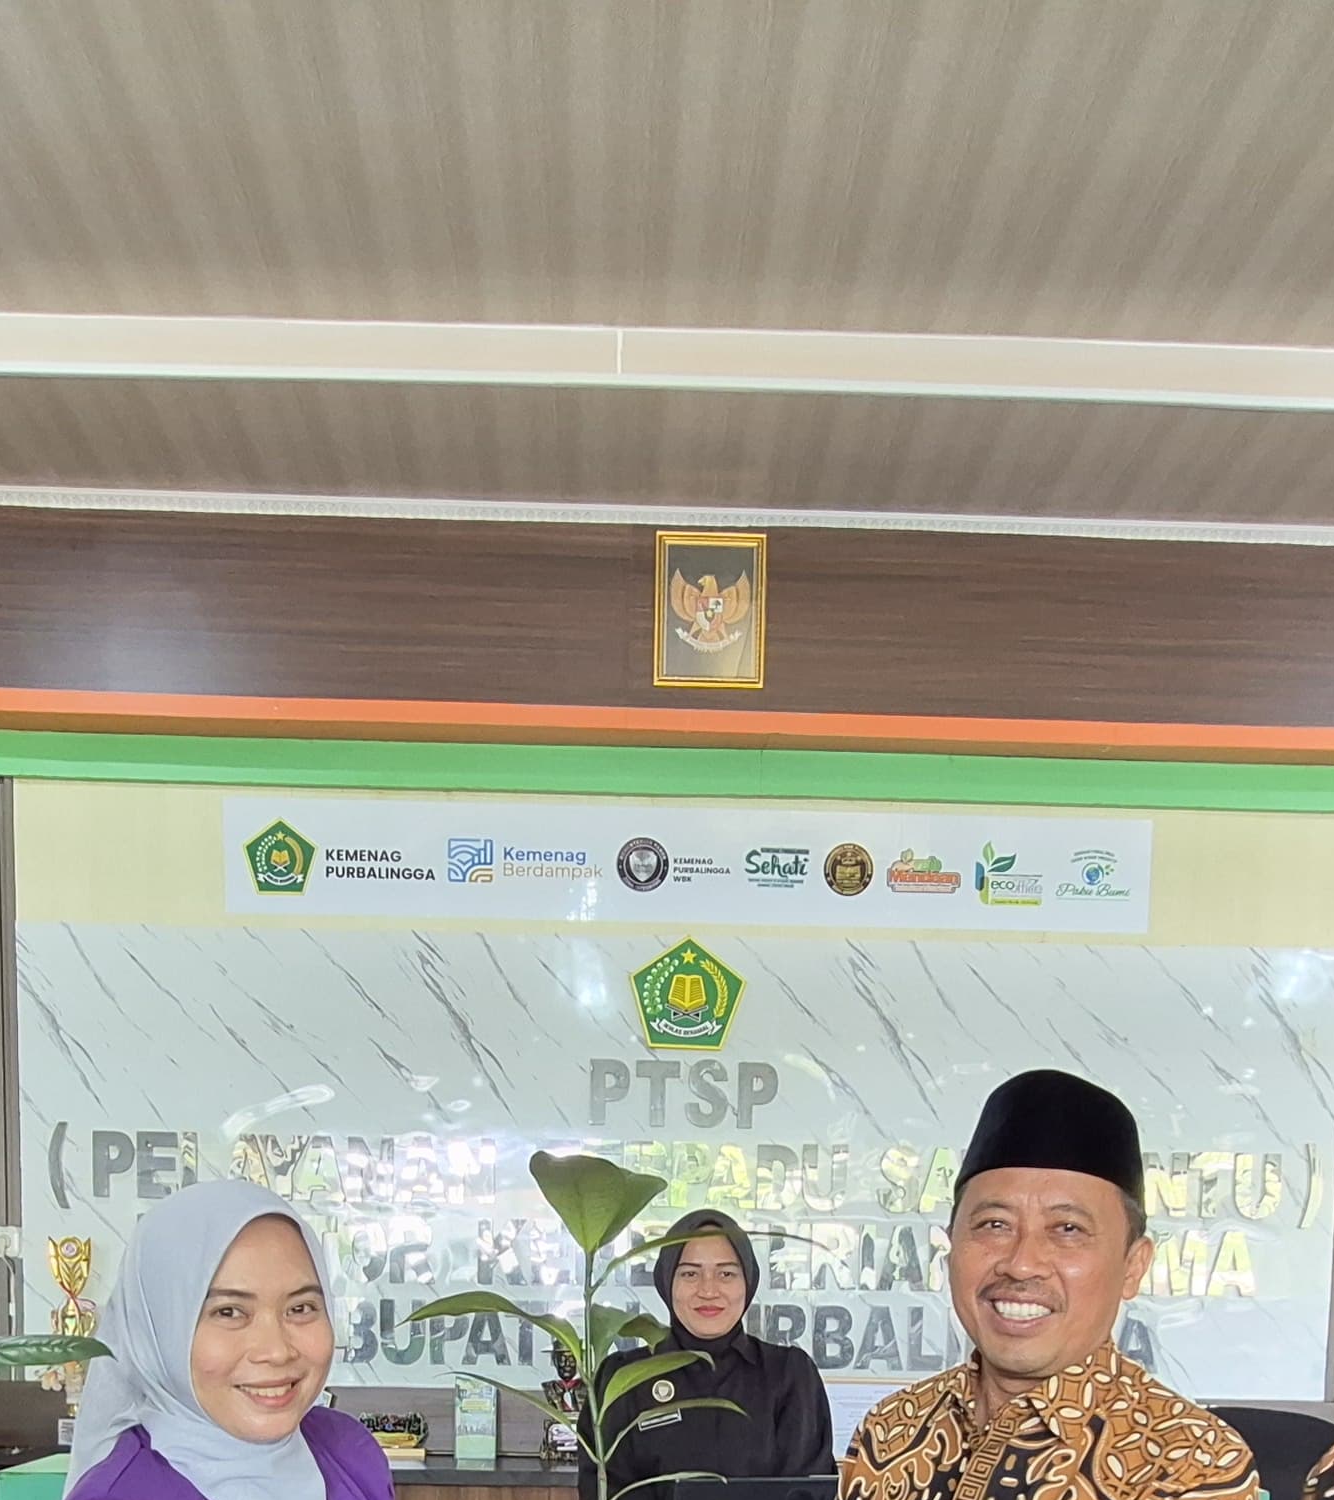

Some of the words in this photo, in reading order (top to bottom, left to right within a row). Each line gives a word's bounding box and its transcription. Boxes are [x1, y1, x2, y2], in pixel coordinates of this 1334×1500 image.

[325, 849, 402, 863] KEMENAG
[503, 847, 587, 866] Kemenag
[673, 857, 714, 866] KEMENAG
[744, 849, 810, 878] Sehati
[325, 865, 436, 881] PURBALINGGA
[503, 863, 603, 880] Berdampak
[673, 866, 731, 875] PURBALINGGA
[589, 1058, 779, 1130] PTSP
[875, 1144, 962, 1214] SA
[1142, 1152, 1283, 1220] NTU
